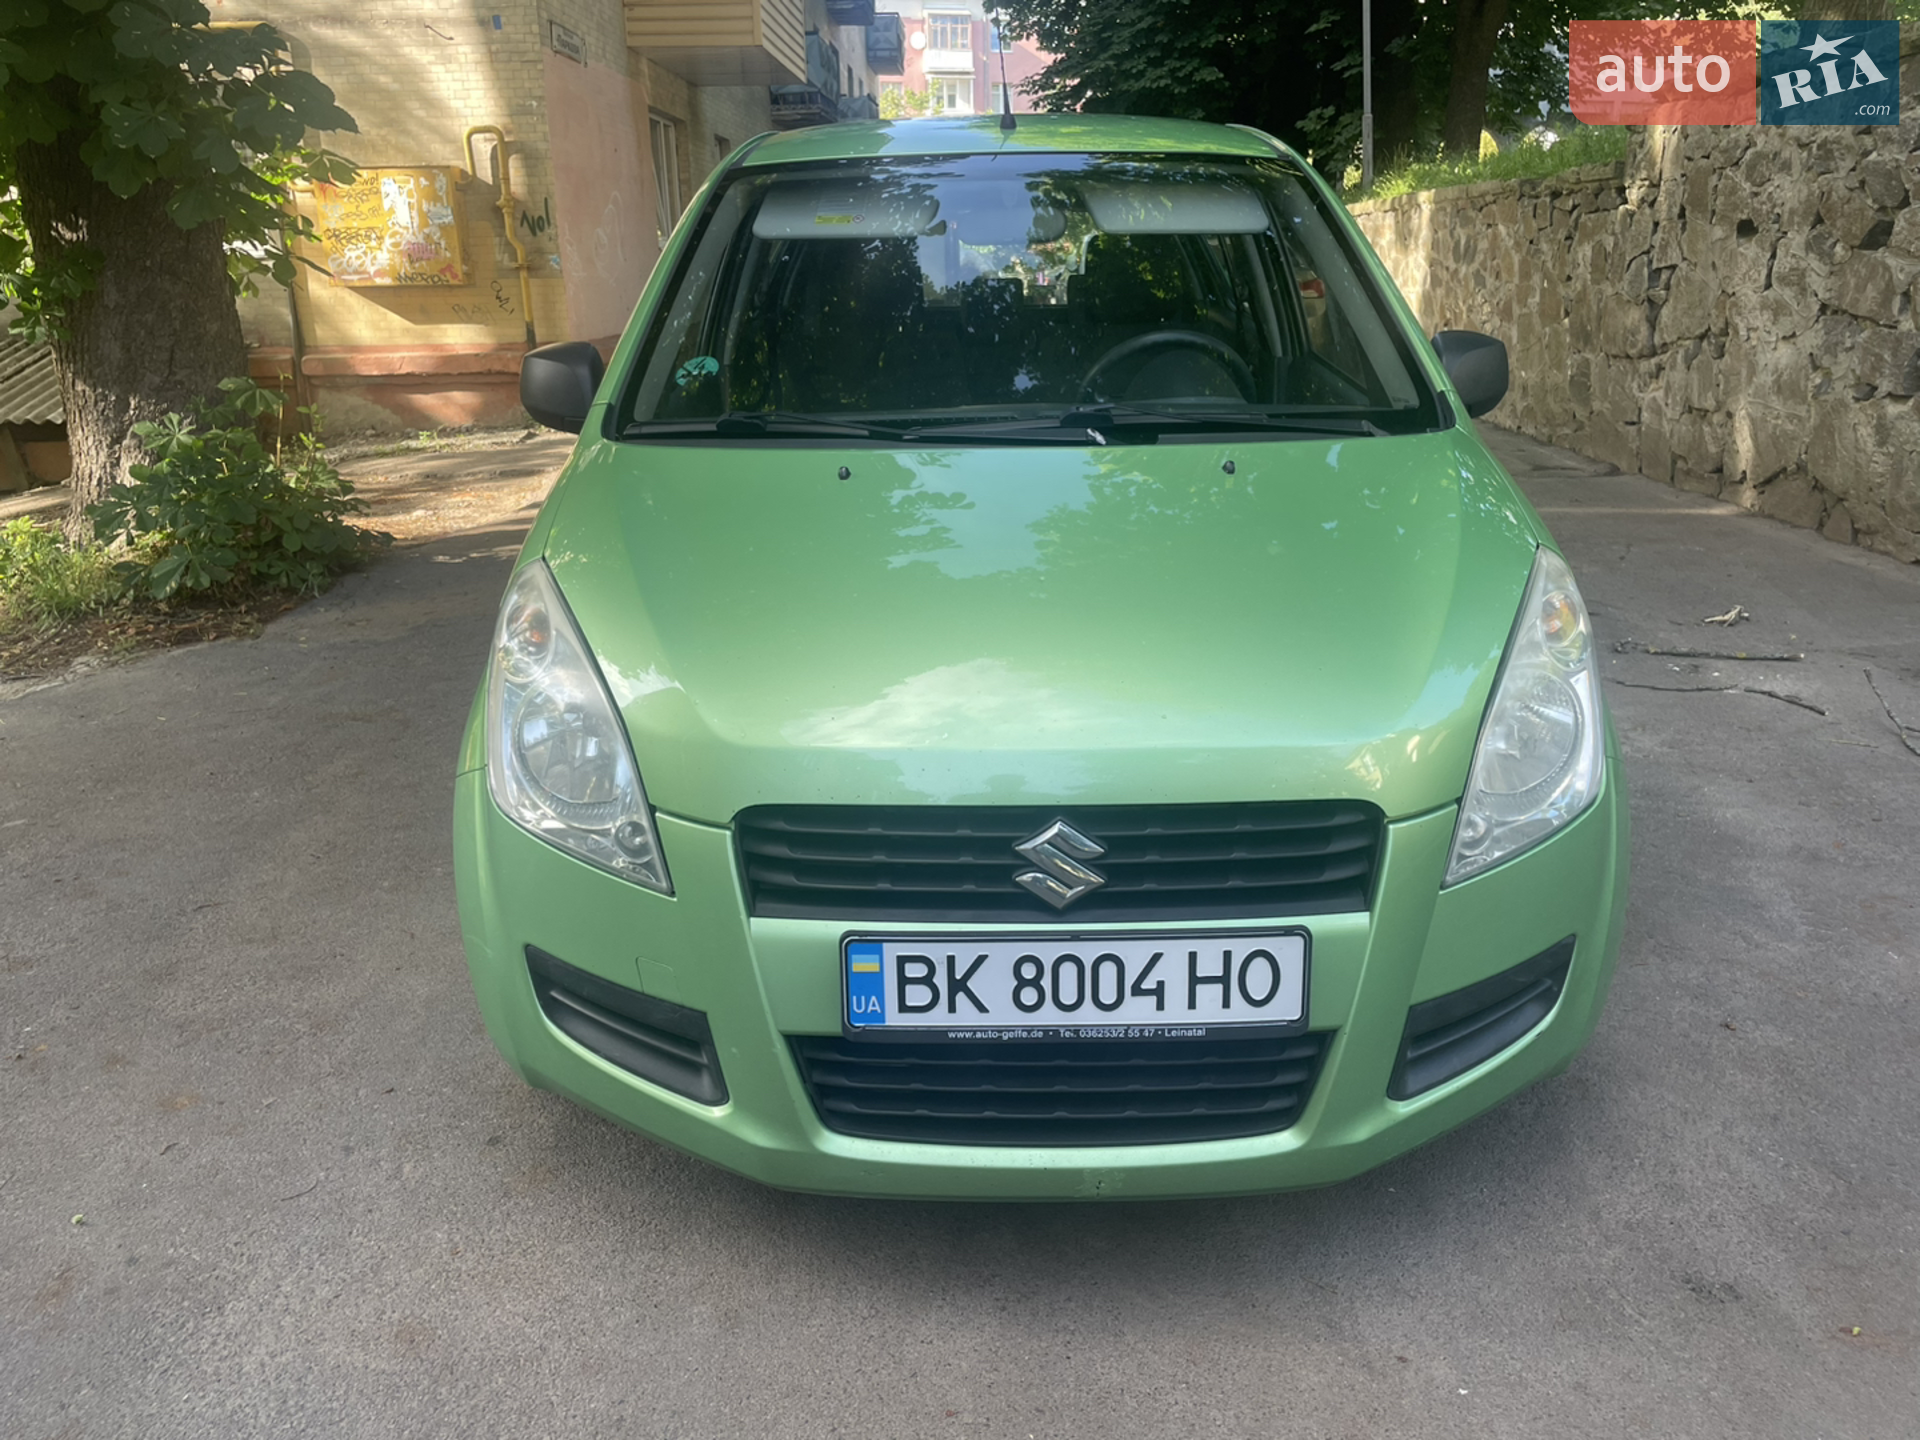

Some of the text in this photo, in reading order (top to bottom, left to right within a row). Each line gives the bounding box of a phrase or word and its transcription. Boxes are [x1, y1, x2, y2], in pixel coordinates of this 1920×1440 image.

[895, 949, 1281, 1014] BK 8004 HO
[852, 995, 882, 1014] UA
